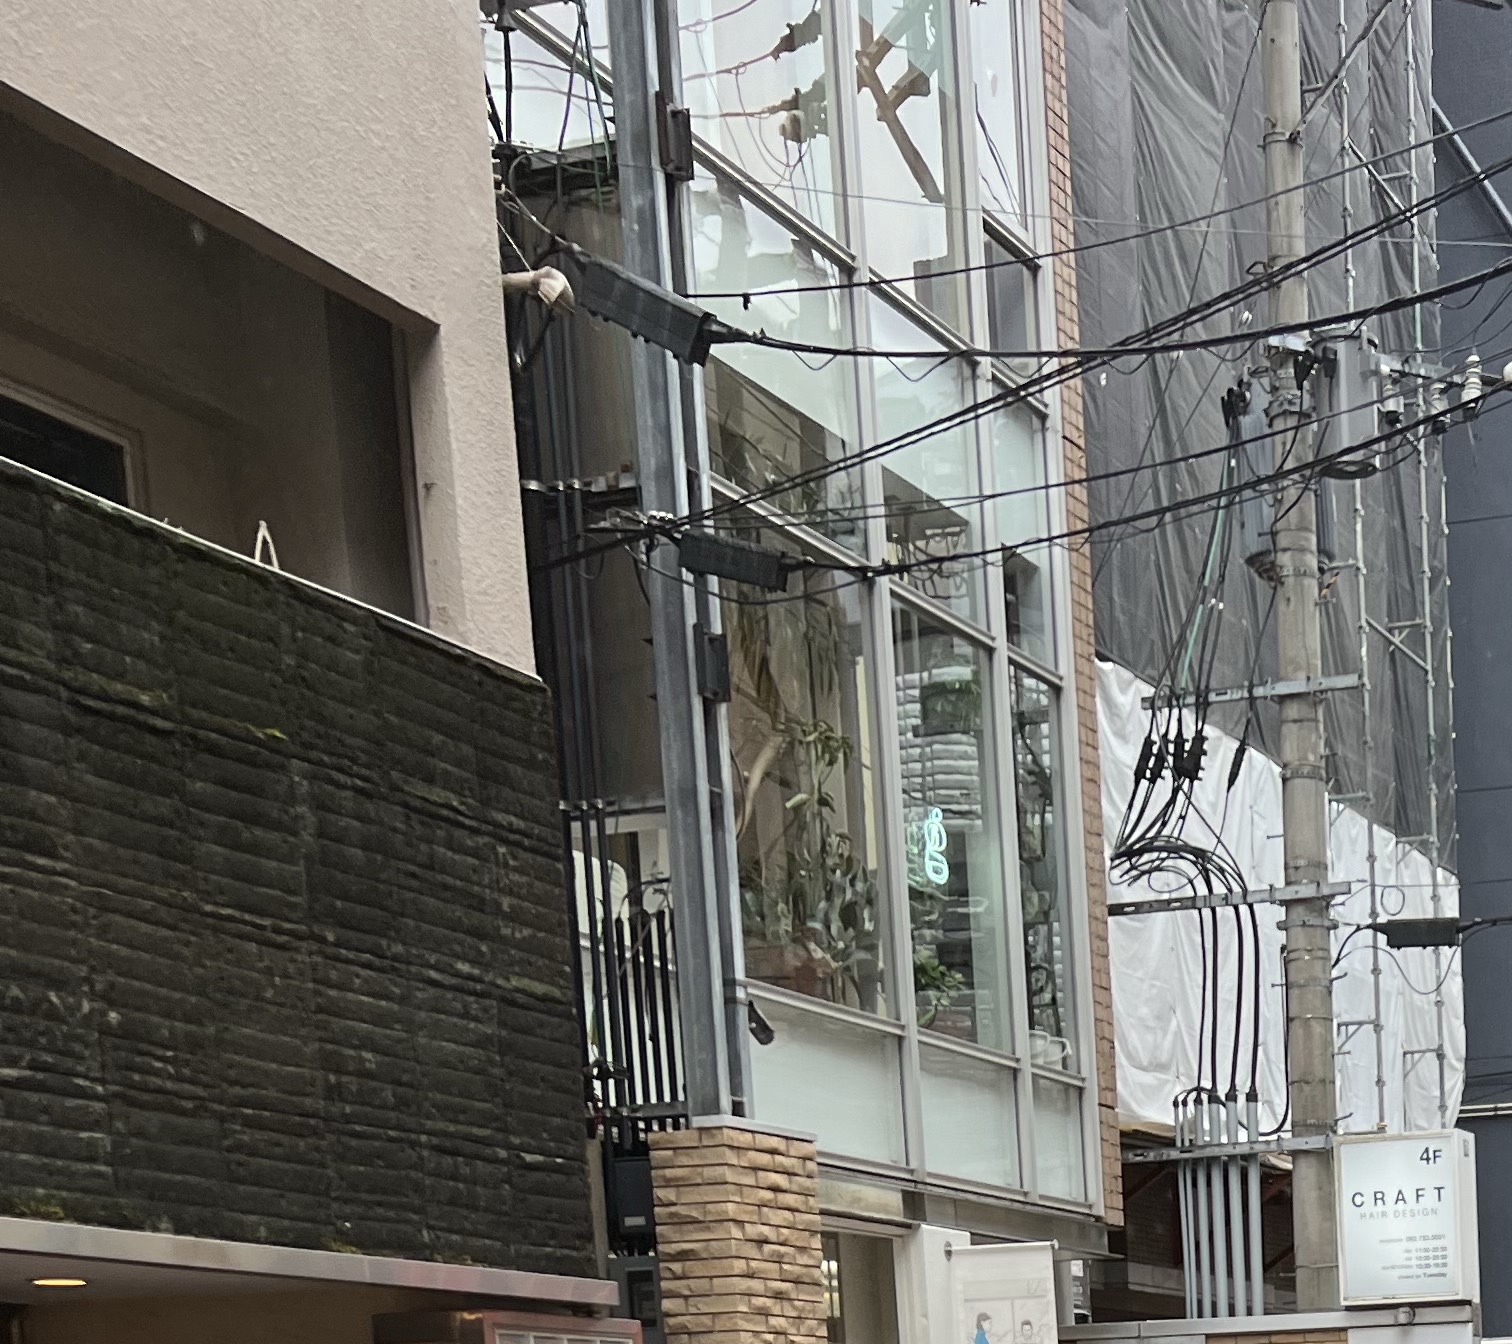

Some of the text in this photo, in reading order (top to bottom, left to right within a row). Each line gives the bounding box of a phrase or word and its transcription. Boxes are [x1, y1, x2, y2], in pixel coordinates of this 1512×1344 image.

[1419, 1146, 1443, 1165] 4F
[1351, 1186, 1445, 1208] CRAFT
[1360, 1207, 1438, 1220] HAIR DESIGN
